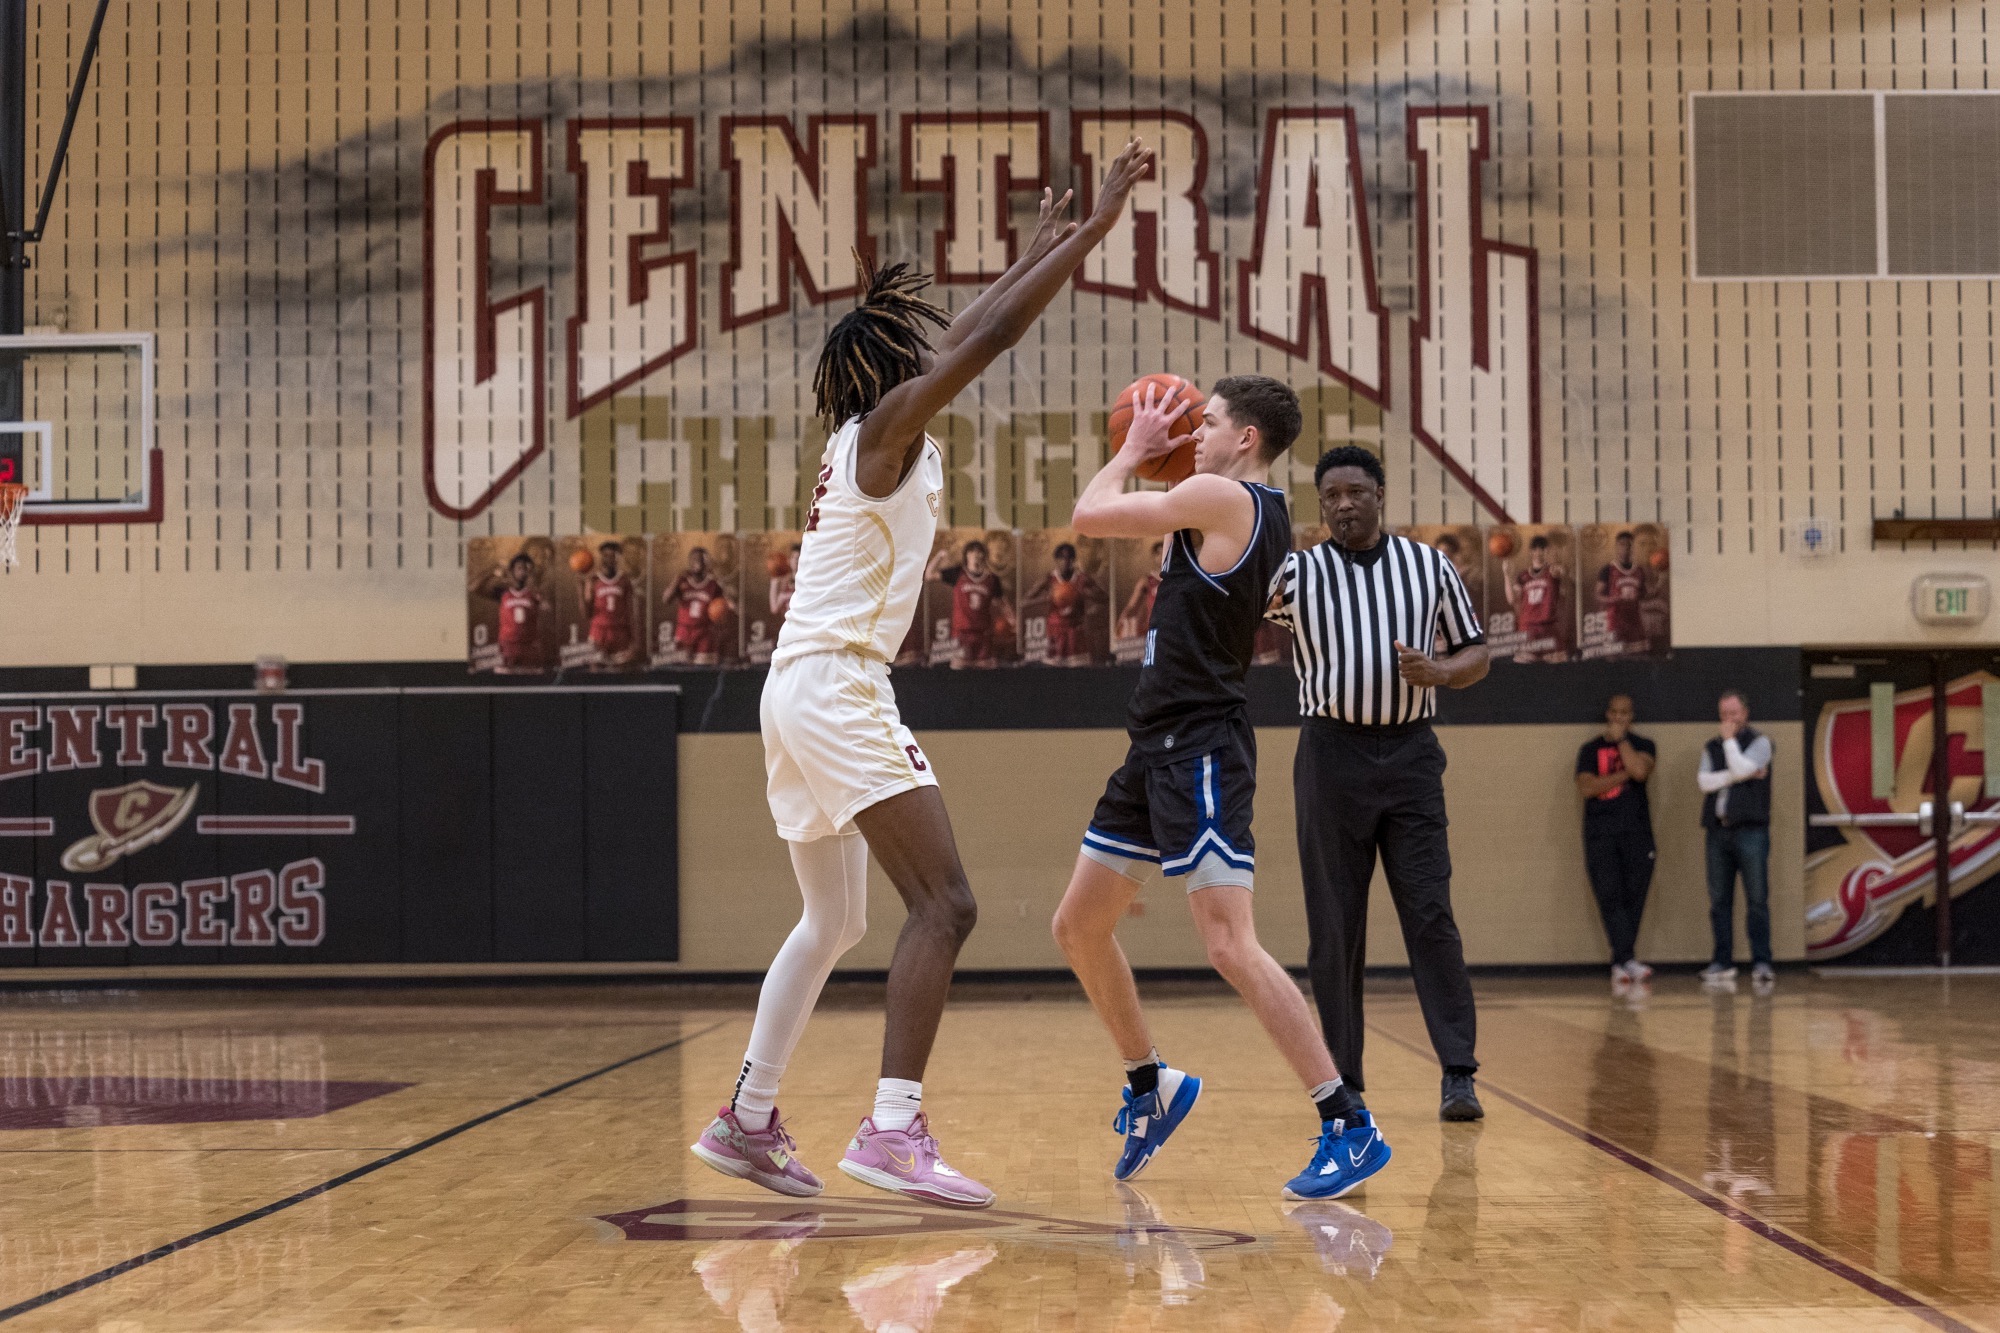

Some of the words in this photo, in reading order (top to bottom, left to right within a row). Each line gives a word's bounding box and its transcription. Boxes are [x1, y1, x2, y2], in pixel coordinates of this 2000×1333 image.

[424, 106, 1539, 524] CENTRAL
[1935, 587, 1968, 614] EXIT
[473, 624, 488, 646] 0
[751, 620, 766, 642] 3
[935, 618, 950, 640] 5
[1024, 616, 1046, 638] 10
[905, 744, 927, 772] C
[113, 791, 150, 830] C
